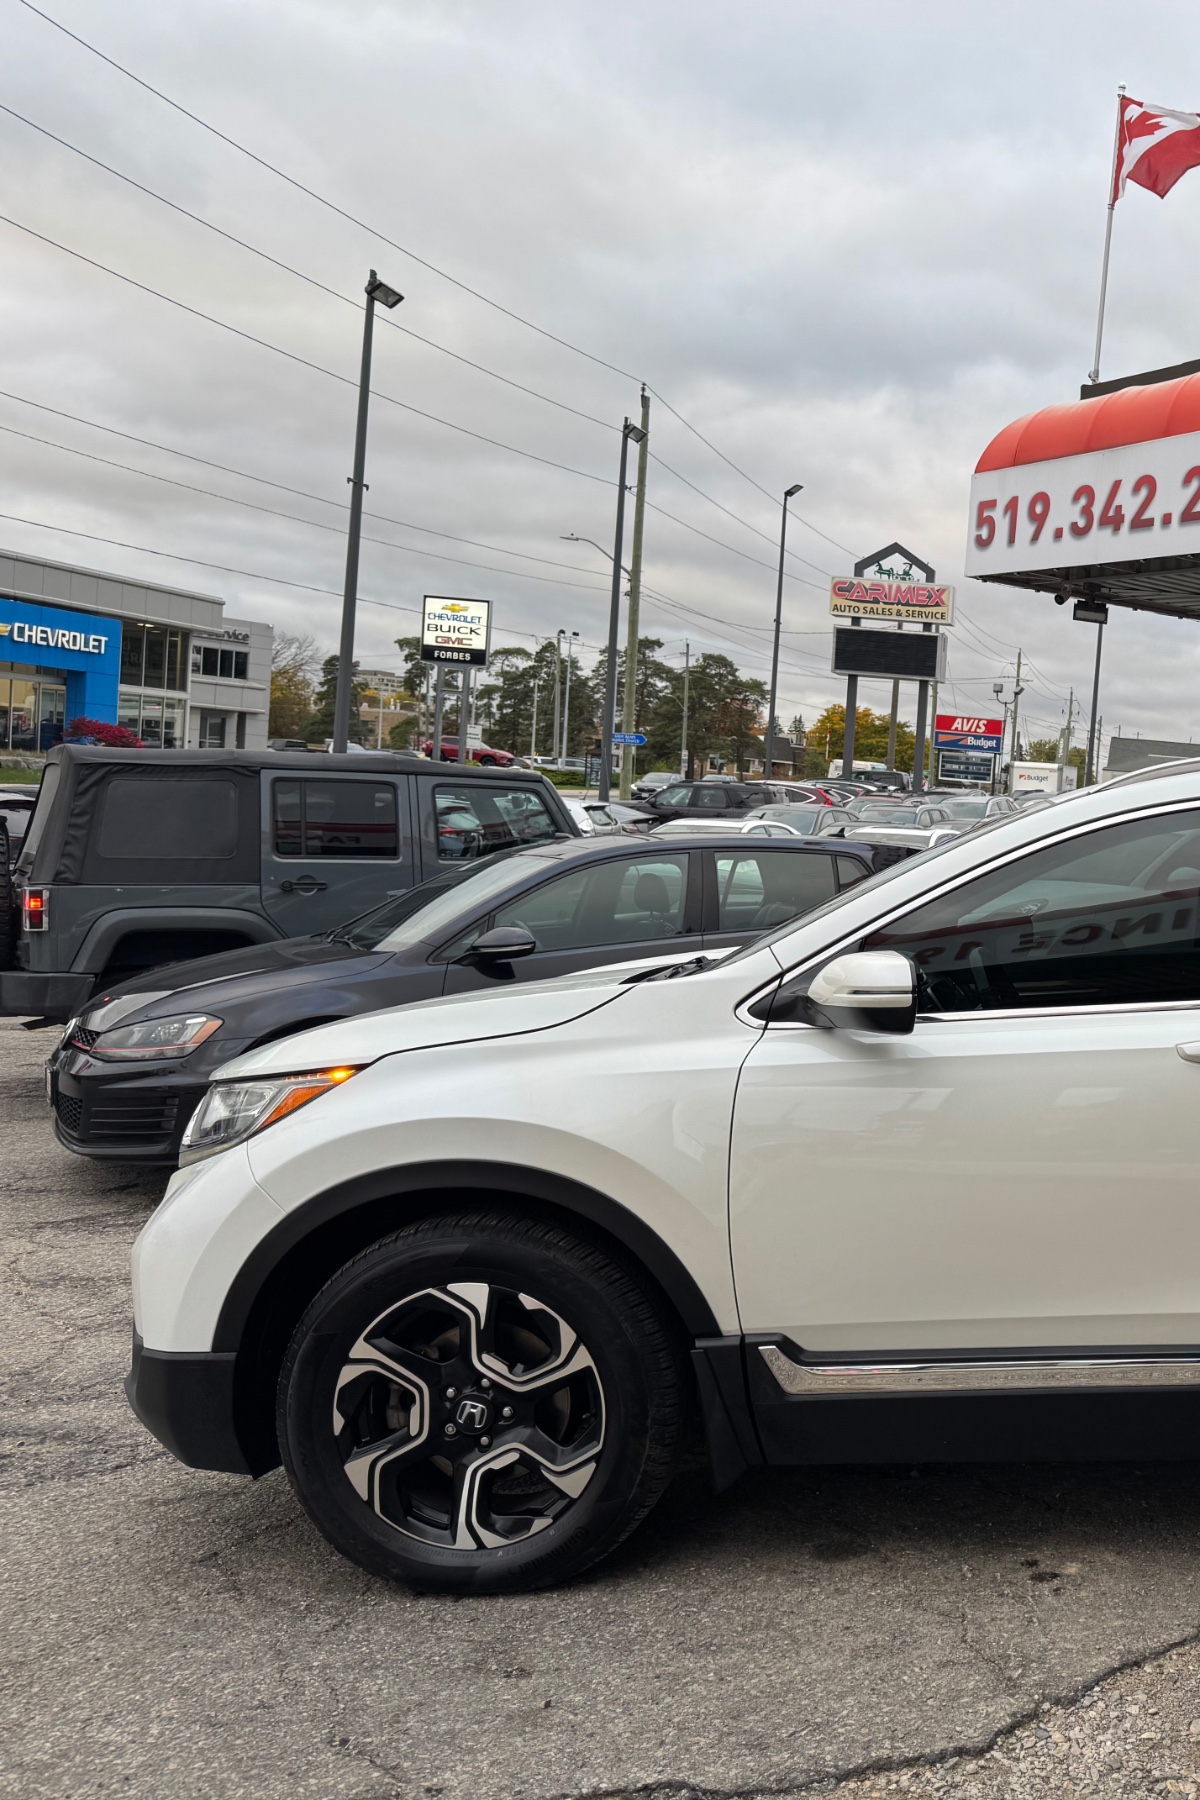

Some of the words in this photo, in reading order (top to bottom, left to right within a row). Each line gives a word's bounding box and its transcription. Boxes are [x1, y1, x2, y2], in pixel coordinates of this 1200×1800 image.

[832, 580, 950, 606] CARIMEX
[428, 612, 483, 624] CHEVROLET
[832, 604, 860, 614] AUTO
[862, 605, 893, 616] SALES
[895, 608, 903, 617] &
[903, 609, 947, 620] SERVICE
[427, 623, 481, 636] BUICK
[13, 622, 108, 655] CHEVROLET
[435, 636, 473, 647] GMC
[434, 650, 471, 661] FORBES
[951, 717, 988, 733] AVIS
[967, 736, 997, 749] Budget
[1026, 774, 1049, 782] Budget
